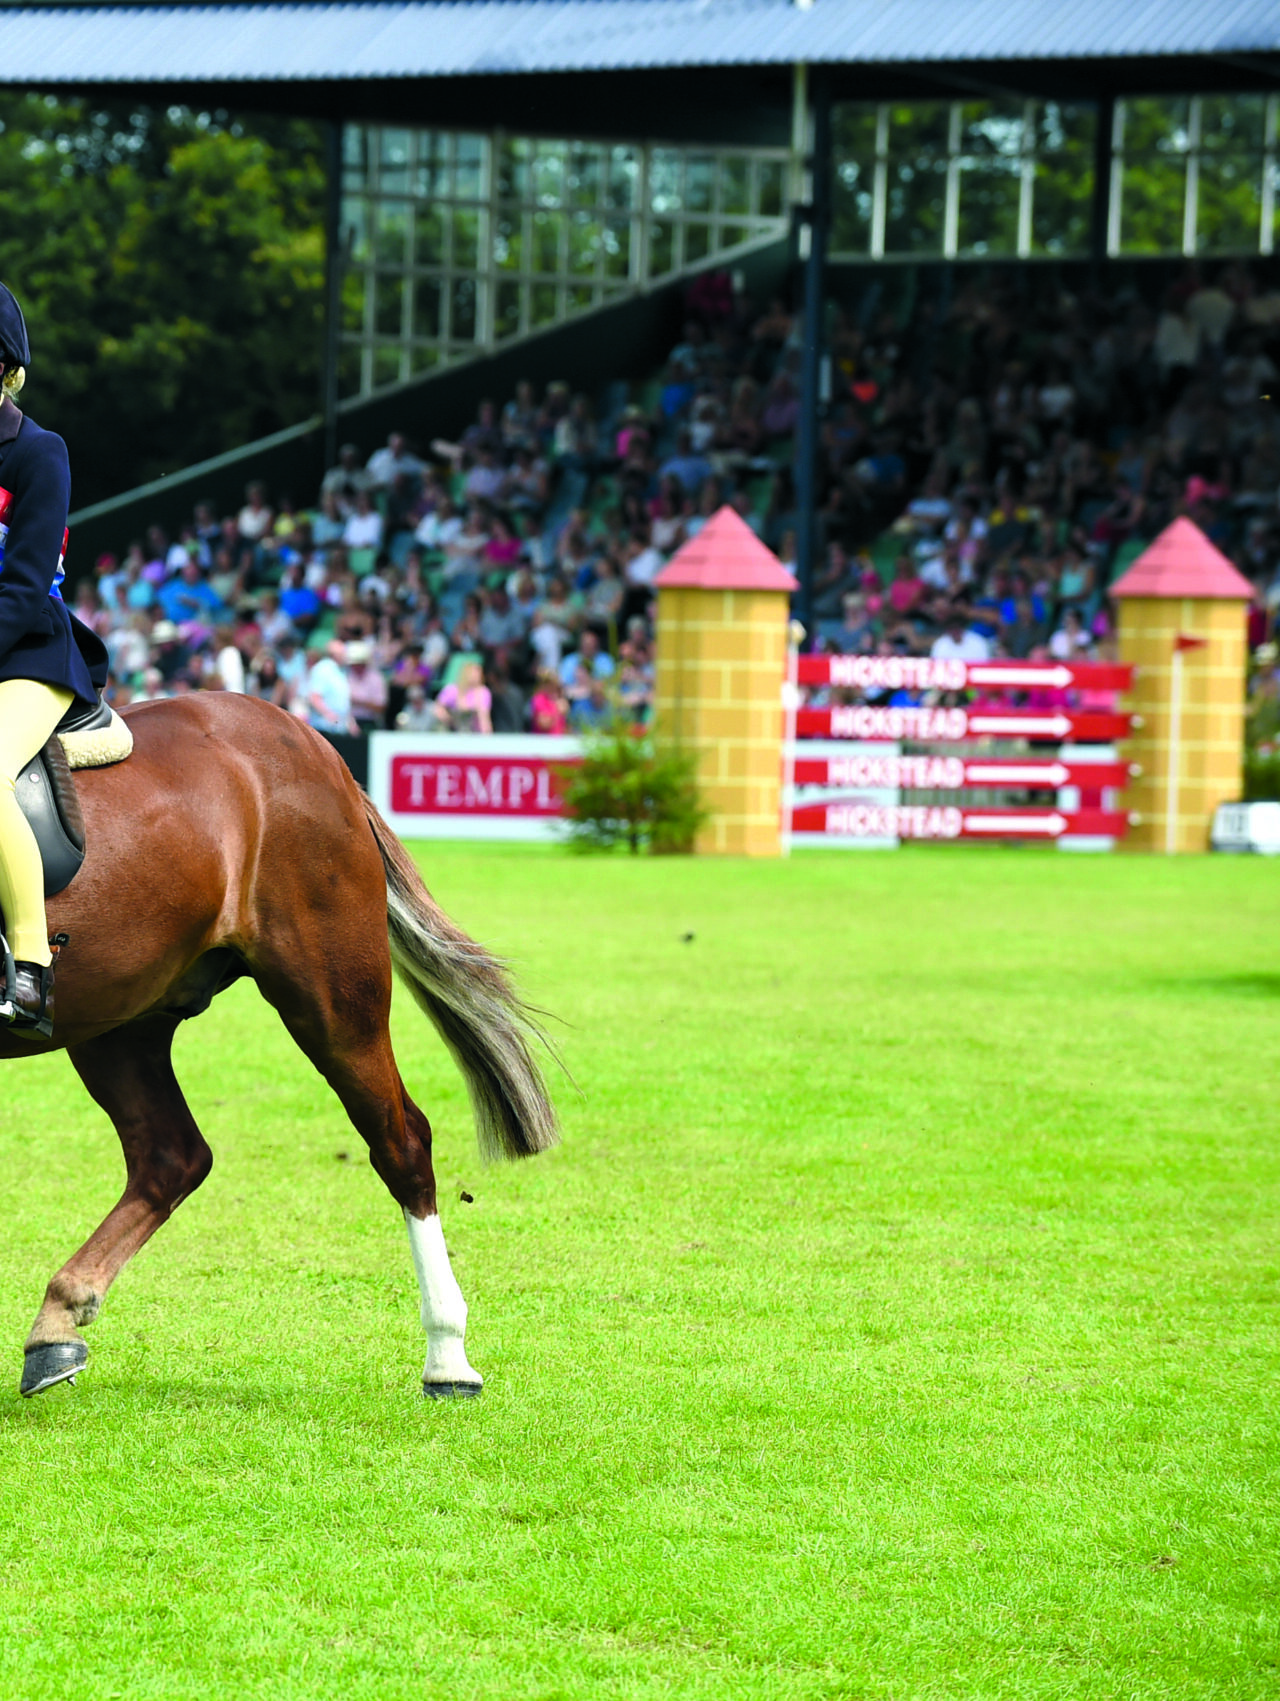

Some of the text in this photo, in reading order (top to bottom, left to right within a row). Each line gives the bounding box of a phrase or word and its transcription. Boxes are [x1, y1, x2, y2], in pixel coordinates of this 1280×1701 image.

[829, 657, 968, 689] HICKSTEAD
[830, 707, 968, 739] HICKSTEAD
[827, 757, 965, 788] HICKSTEAD
[825, 806, 963, 838] HICKSTEAD
